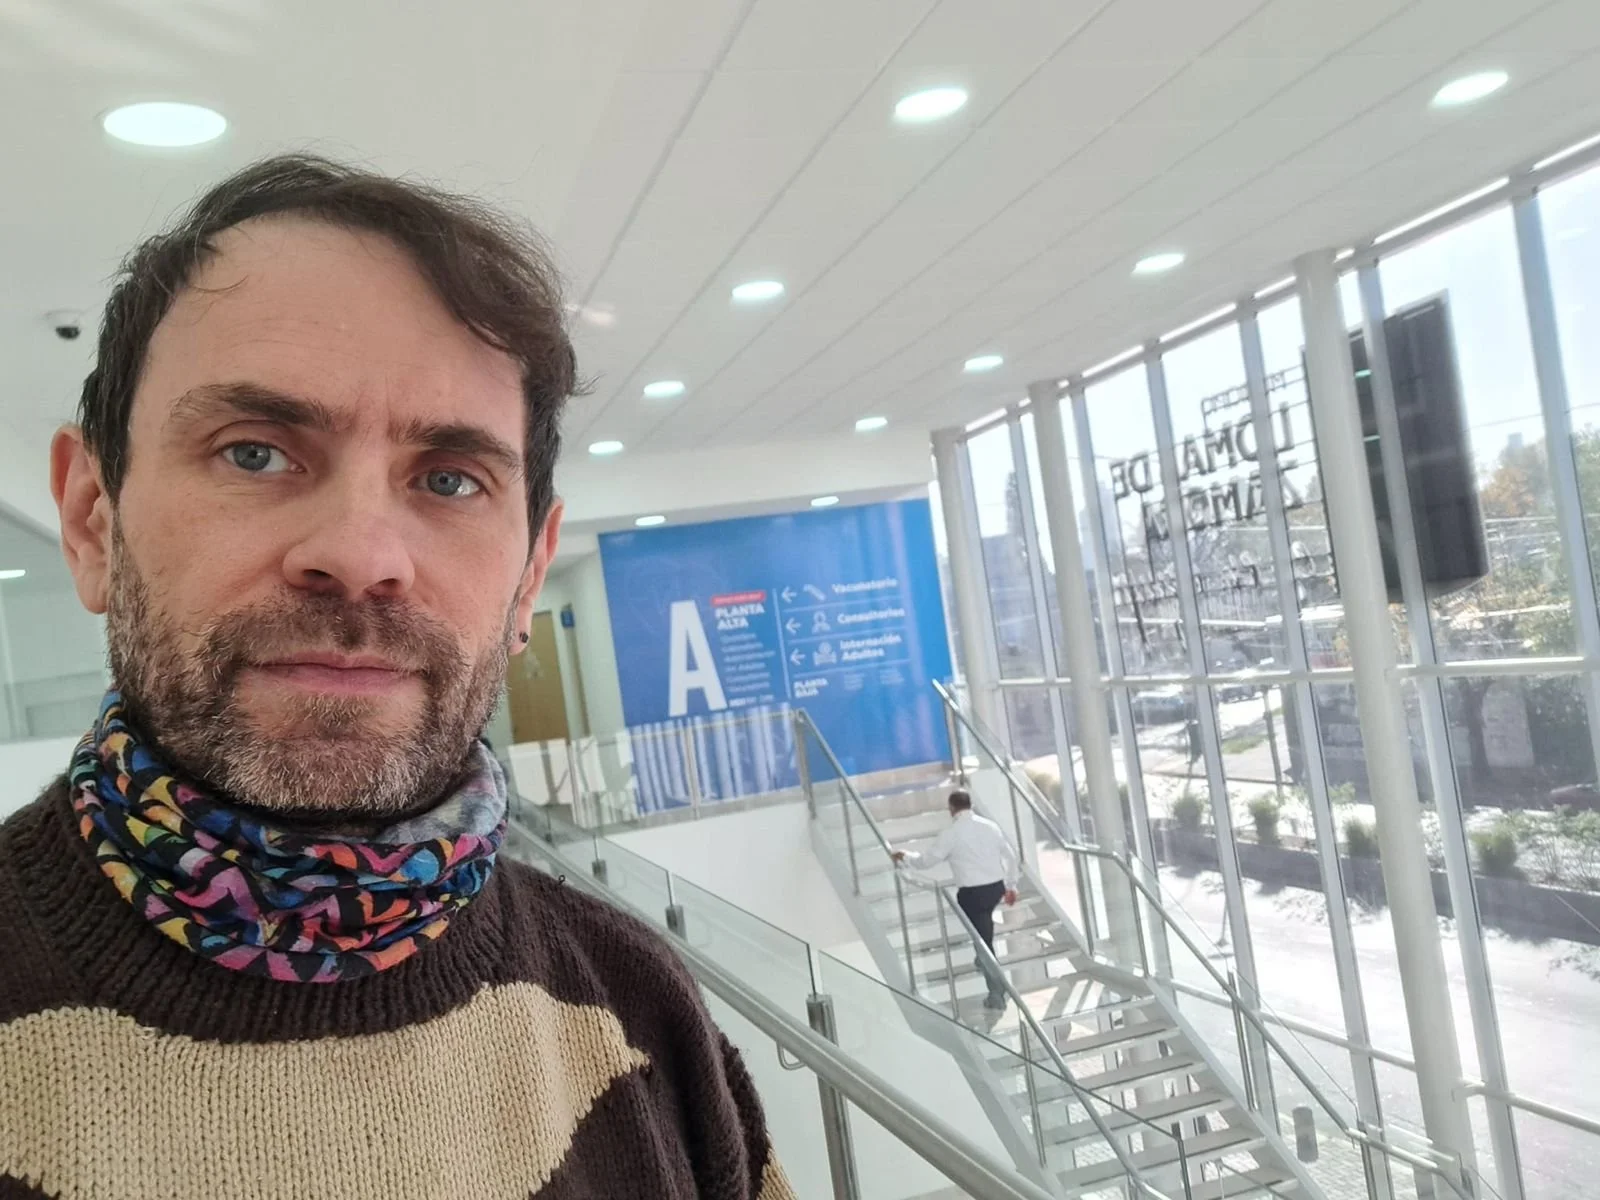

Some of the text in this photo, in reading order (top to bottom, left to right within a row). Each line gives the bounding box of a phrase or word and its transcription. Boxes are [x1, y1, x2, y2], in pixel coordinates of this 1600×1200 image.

[715, 603, 765, 619] PLANTA
[836, 608, 905, 625] Consultorios
[716, 616, 749, 631] ALTA
[668, 600, 728, 717] A
